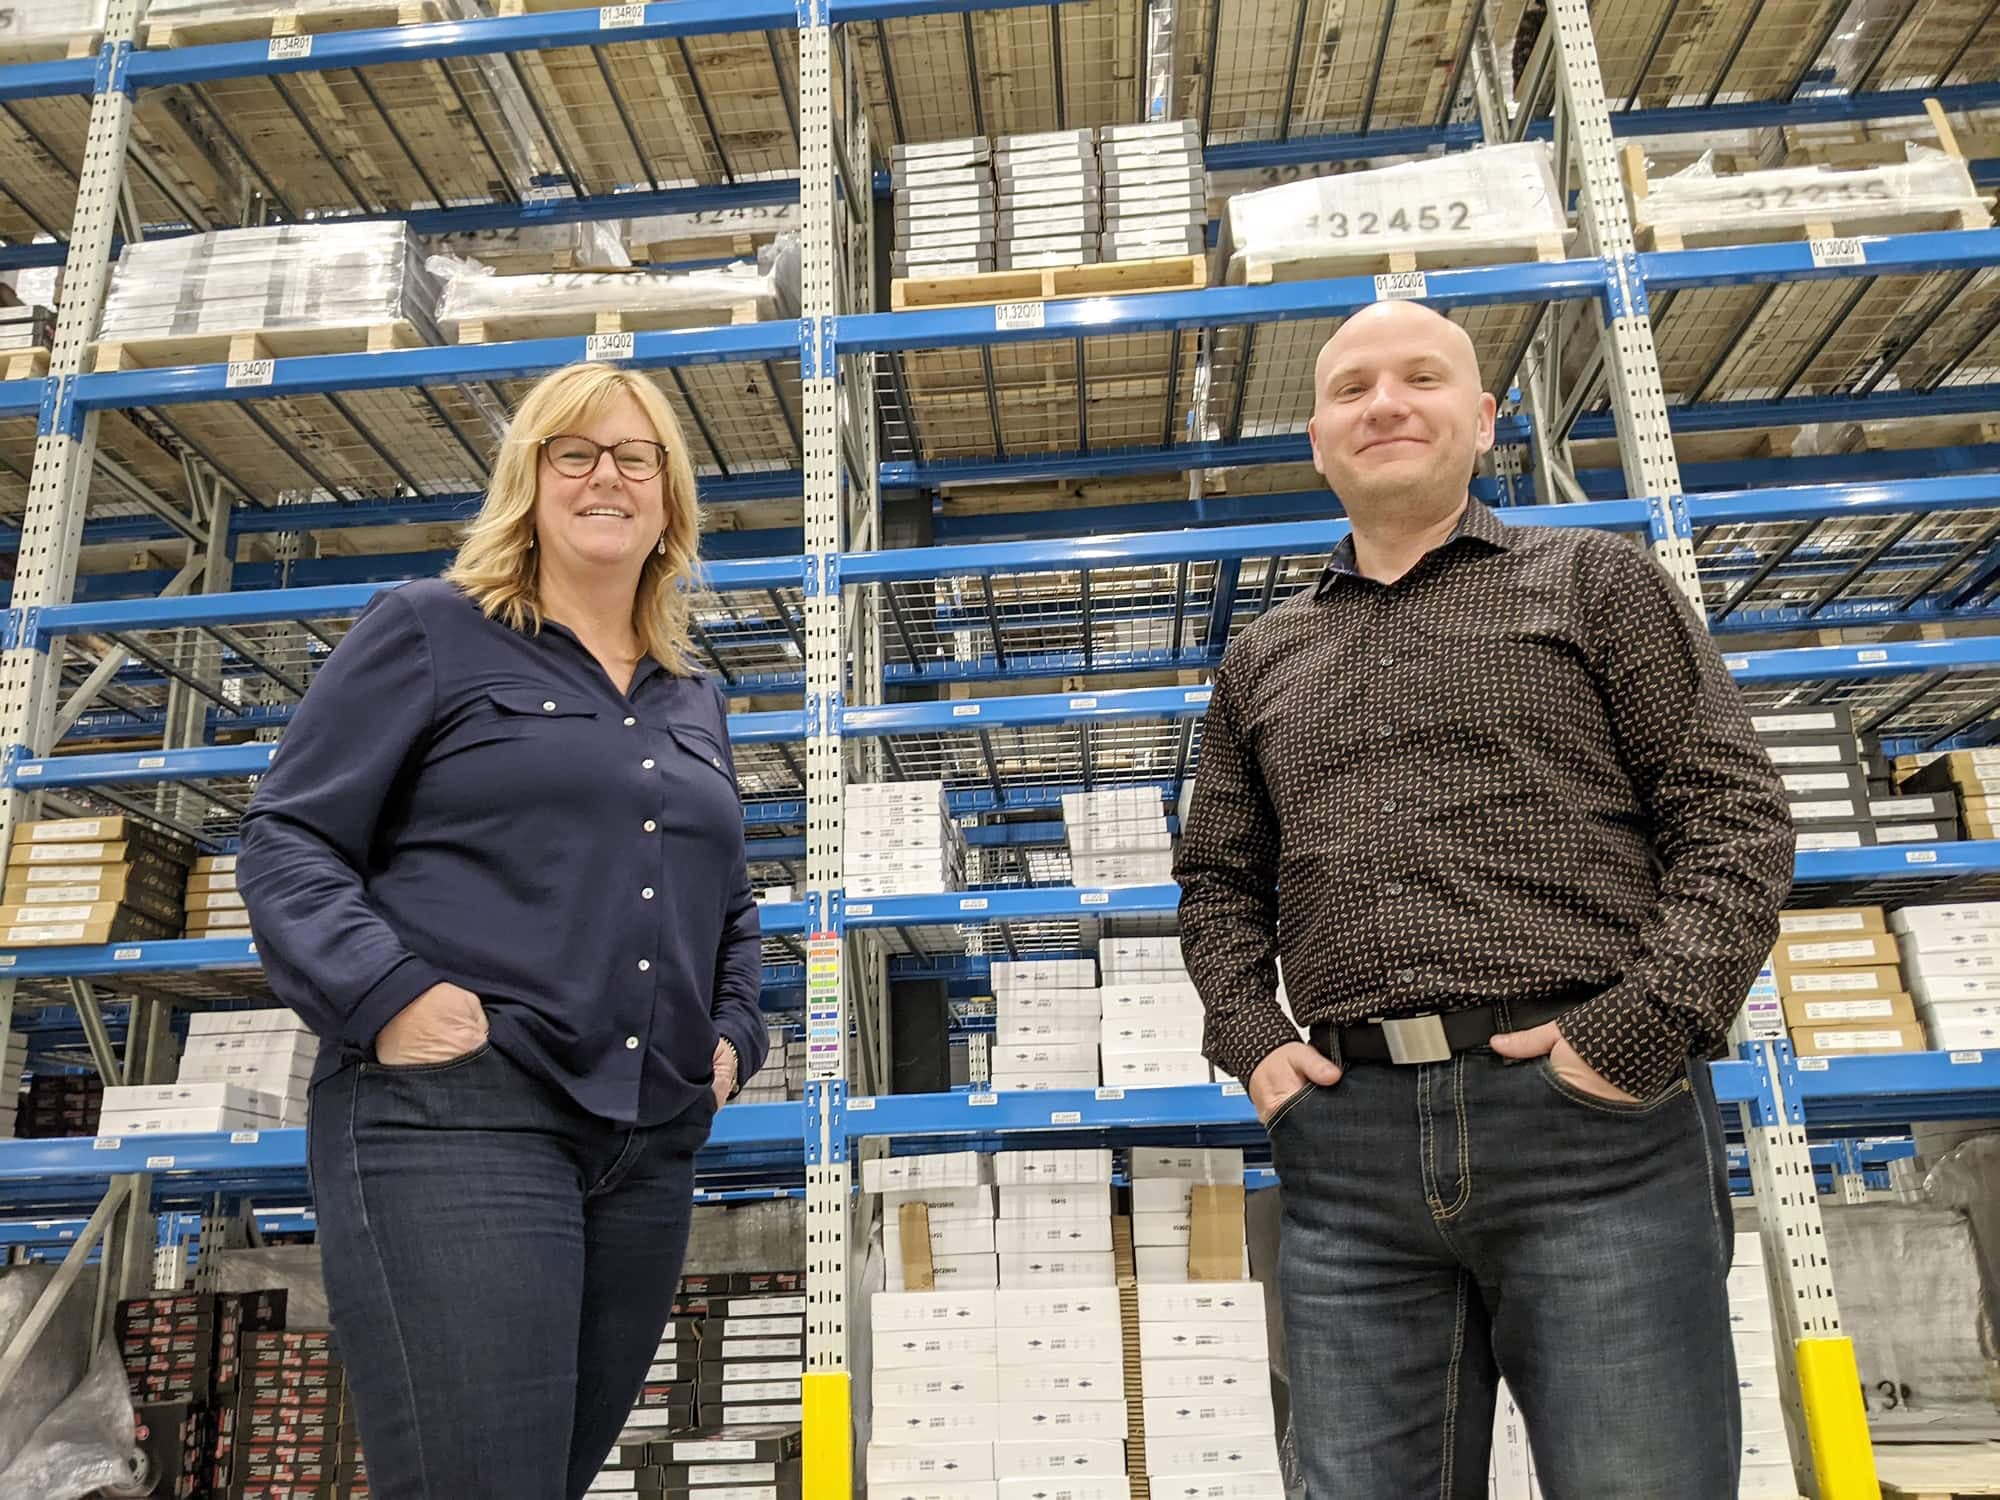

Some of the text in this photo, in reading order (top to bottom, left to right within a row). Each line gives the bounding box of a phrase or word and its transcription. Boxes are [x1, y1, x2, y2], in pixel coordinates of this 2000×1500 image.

[602, 6, 642, 20] 01.34R02
[271, 37, 310, 51] 01.34R01
[1329, 201, 1472, 238] 32452
[1812, 239, 1860, 256] 01.30Q01
[1377, 273, 1424, 290] 01.32Q02
[997, 303, 1041, 320] 01.32Q01
[588, 334, 632, 350] 01.34Q02
[230, 361, 271, 377] 01.34Q01
